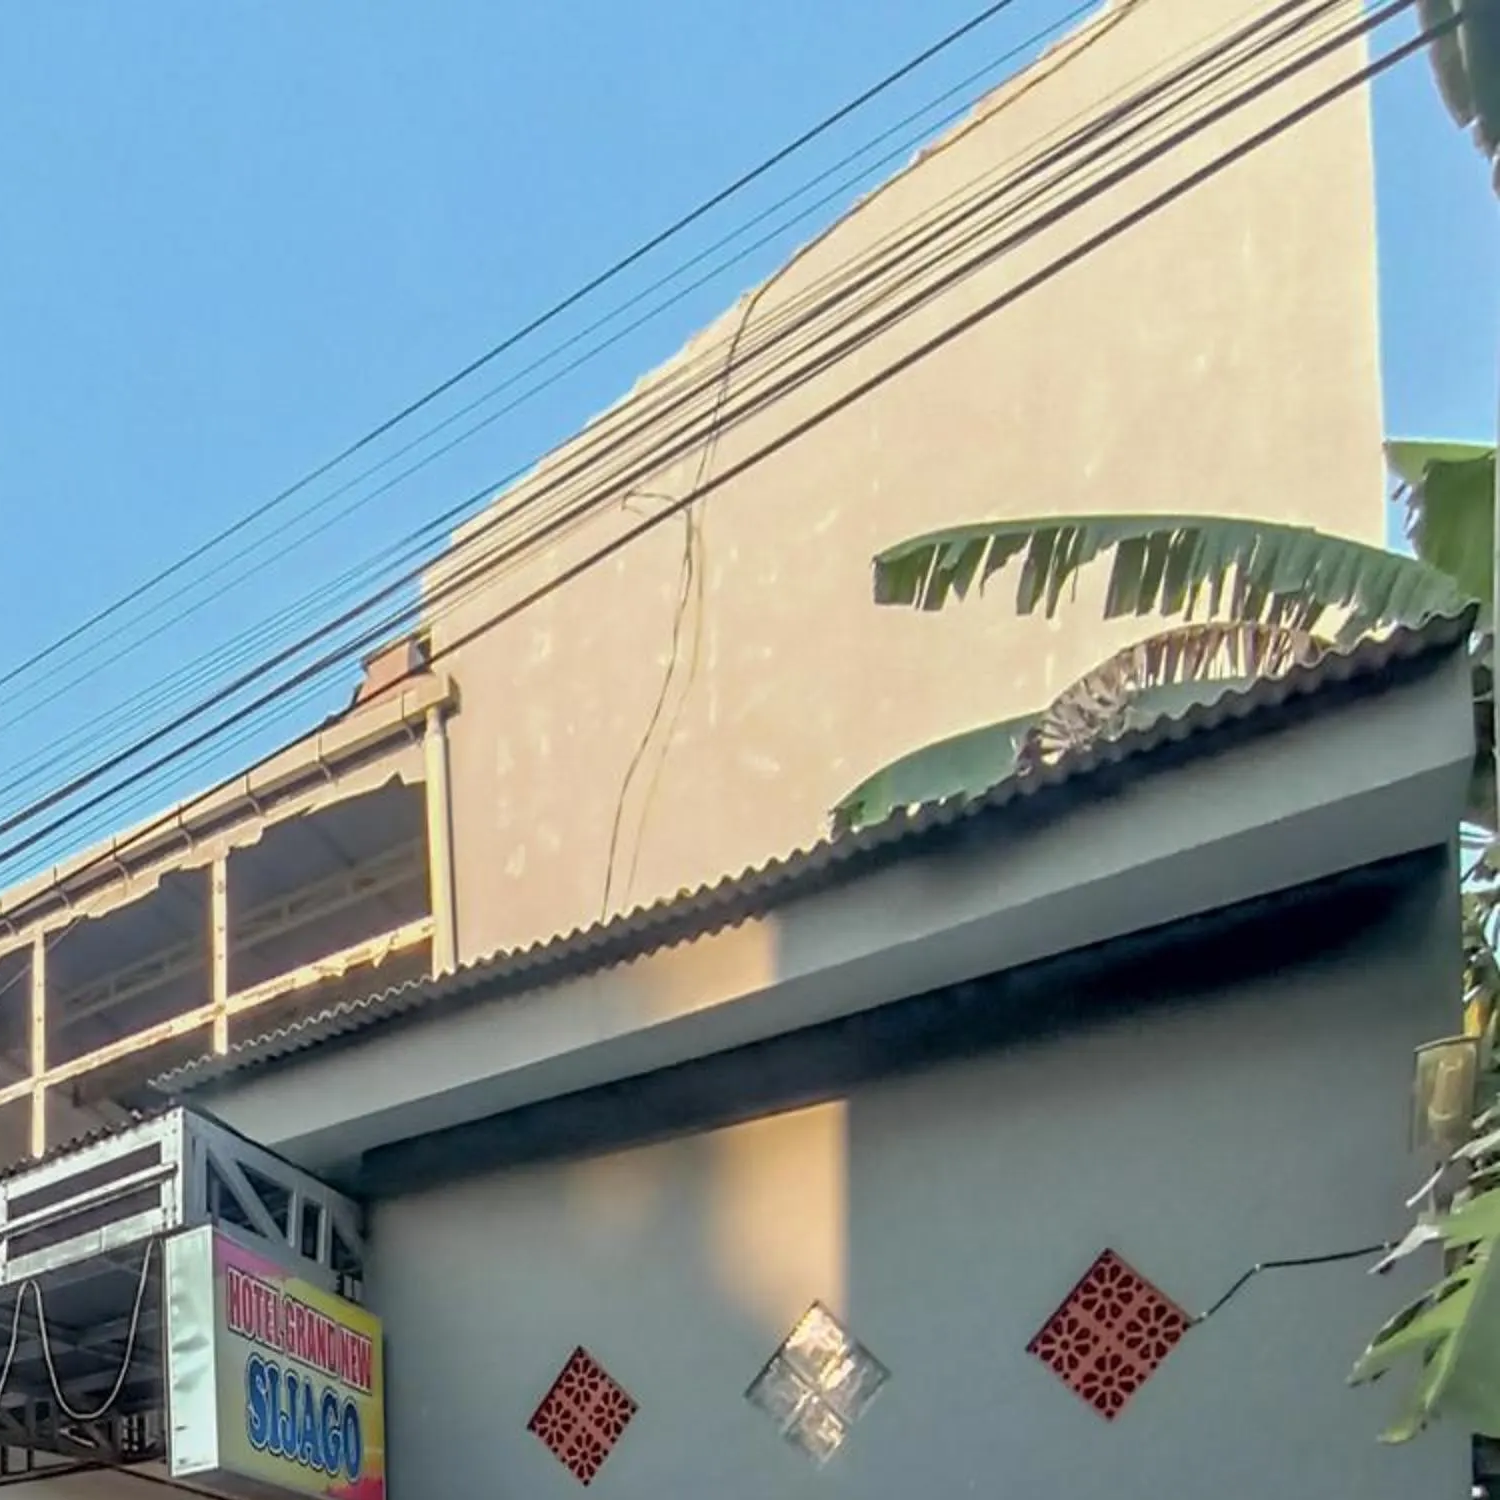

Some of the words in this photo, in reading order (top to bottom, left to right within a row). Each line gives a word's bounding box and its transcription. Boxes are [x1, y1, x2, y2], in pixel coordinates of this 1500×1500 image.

[228, 1266, 284, 1354] HOTEL
[284, 1295, 337, 1377] GRAND
[339, 1325, 373, 1395] NEW
[247, 1353, 362, 1483] SIJAGO
